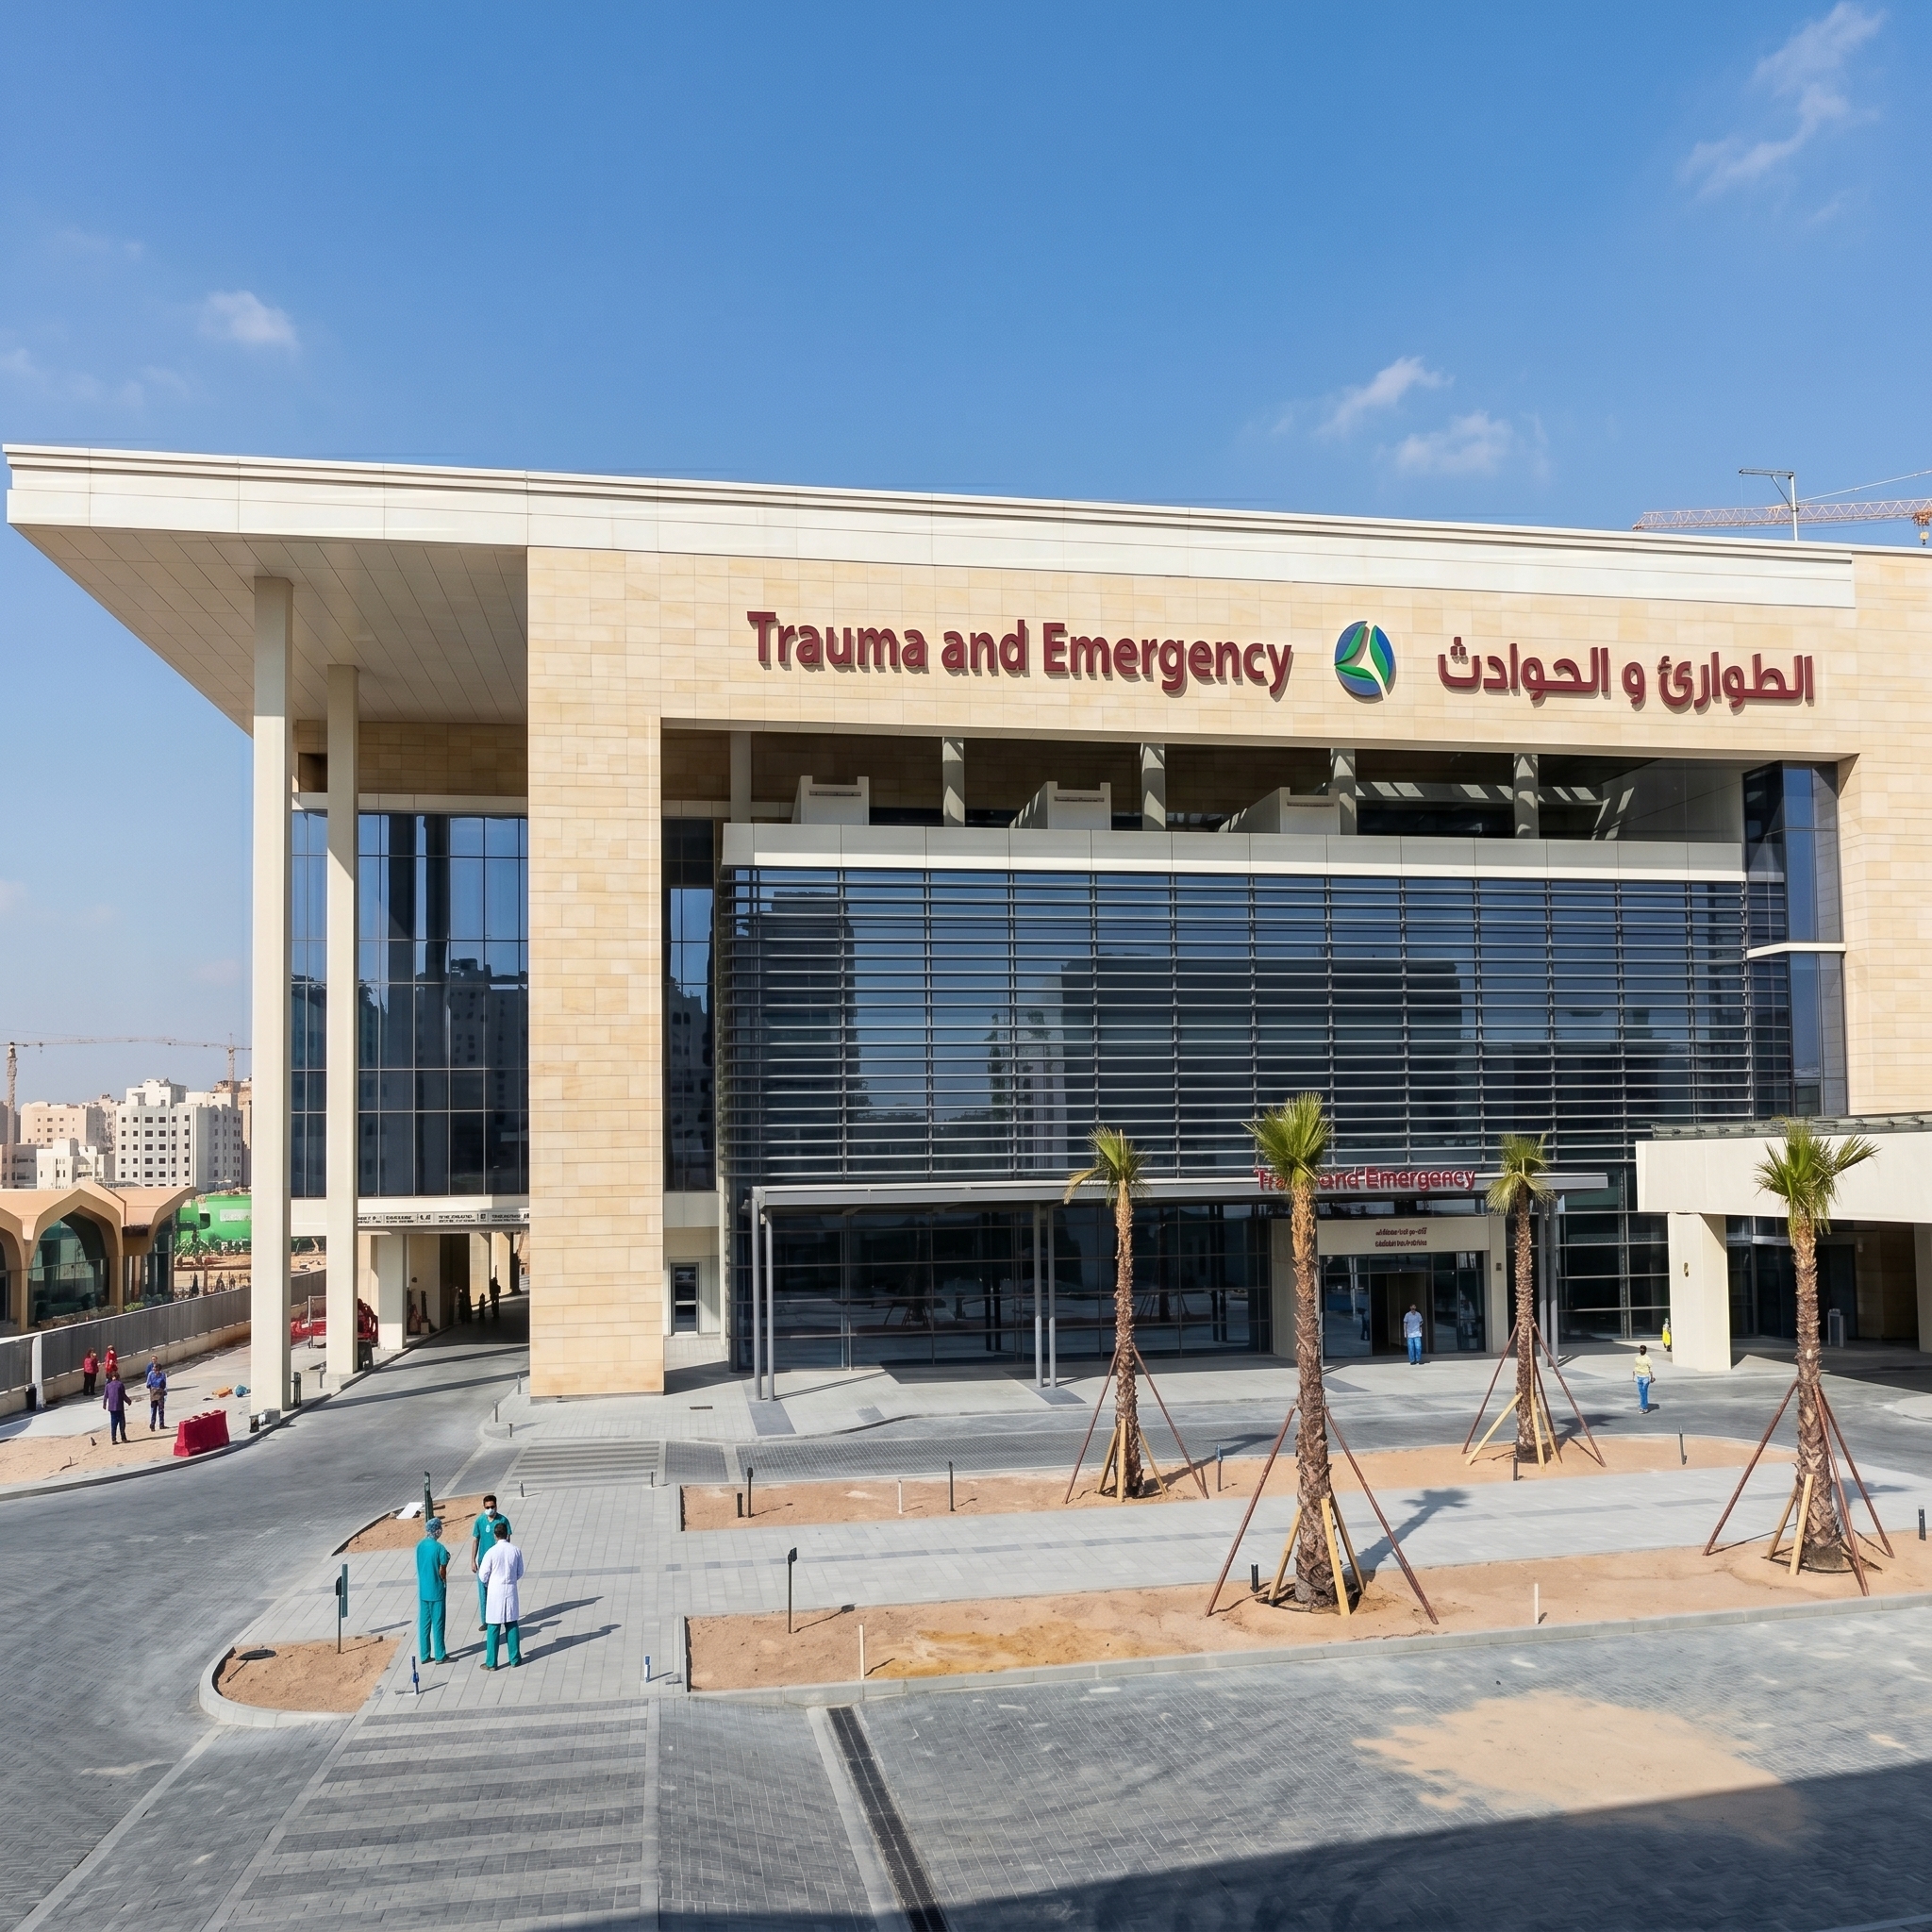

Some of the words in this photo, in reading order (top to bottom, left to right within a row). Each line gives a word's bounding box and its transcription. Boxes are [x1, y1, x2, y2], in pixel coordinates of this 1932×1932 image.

[747, 610, 925, 667] Trauma
[941, 619, 1027, 670] and
[1042, 622, 1292, 698] Emergency
[1438, 637, 1609, 701] الحوادث
[1657, 652, 1815, 708] الطوارئ
[1623, 662, 1645, 704] و
[1319, 1166, 1360, 1190] and
[1364, 1166, 1475, 1191] Emergency
